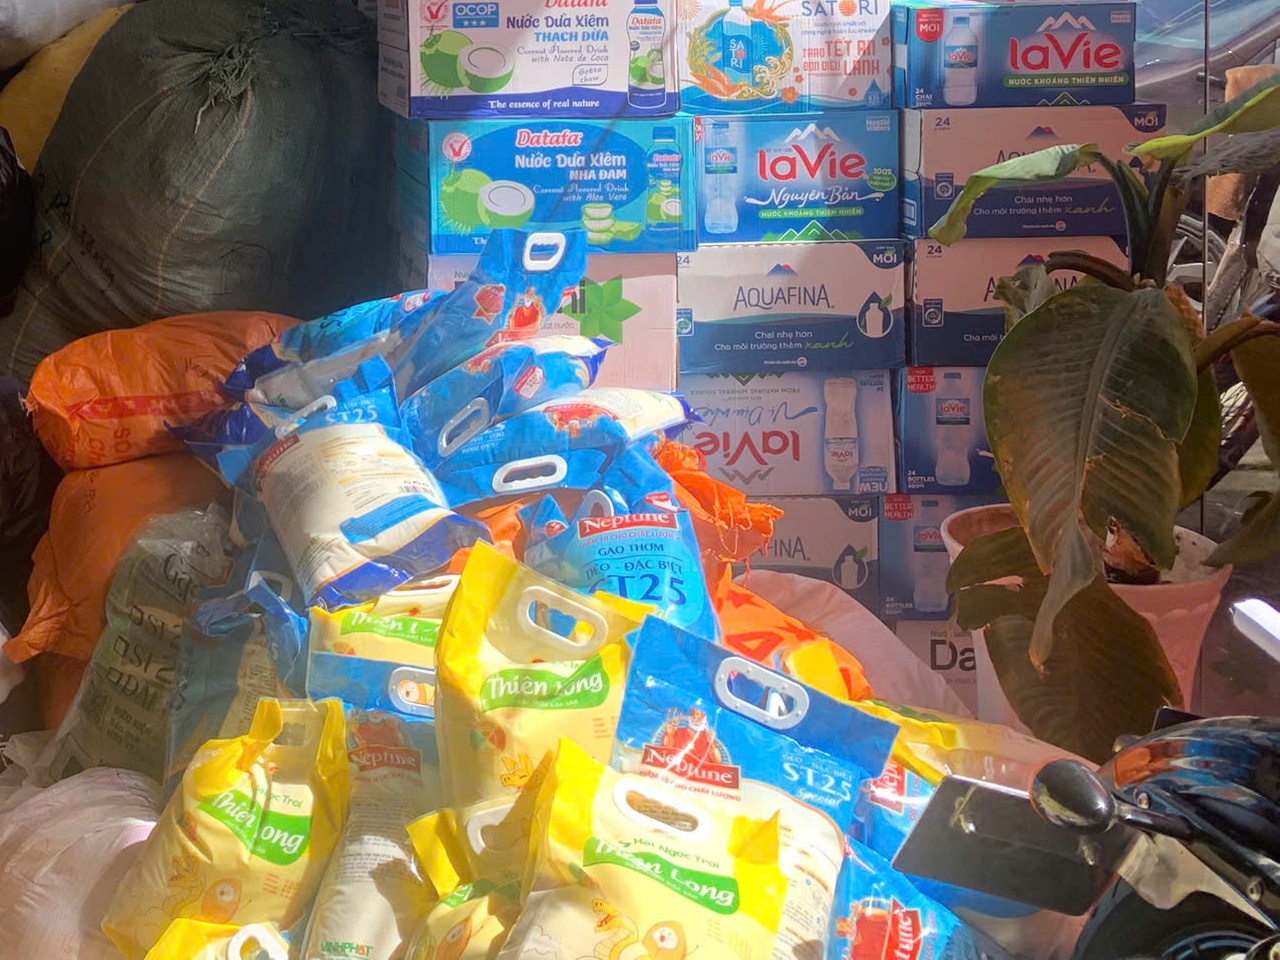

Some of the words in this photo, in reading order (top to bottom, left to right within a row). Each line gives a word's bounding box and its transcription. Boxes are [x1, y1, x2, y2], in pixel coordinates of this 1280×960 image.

[455, 5, 496, 15] OCOP
[507, 14, 540, 29] Nước
[545, 13, 571, 28] Dừa
[576, 16, 608, 28] Xiêm
[1009, 32, 1121, 70] laVie
[488, 100, 506, 108] The
[540, 99, 551, 110] of
[935, 117, 950, 126] 24
[516, 129, 582, 147] Datafa
[515, 151, 551, 167] Nước
[557, 150, 585, 167] Dừa
[590, 153, 626, 166] Xiêm
[759, 143, 866, 180] laVie
[570, 169, 596, 180] NHA
[599, 169, 626, 179] ĐAM
[928, 246, 942, 254] 24
[734, 284, 831, 311] AQUAFINA
[805, 332, 854, 349] xanh
[940, 404, 966, 414] laVie
[694, 430, 799, 466] laVie
[884, 502, 912, 511] BETTER
[885, 510, 913, 519] HEALTH
[584, 513, 670, 533] Neptune
[647, 749, 734, 784] Neptune
[782, 761, 852, 803] ST25
[670, 868, 735, 907] Long
